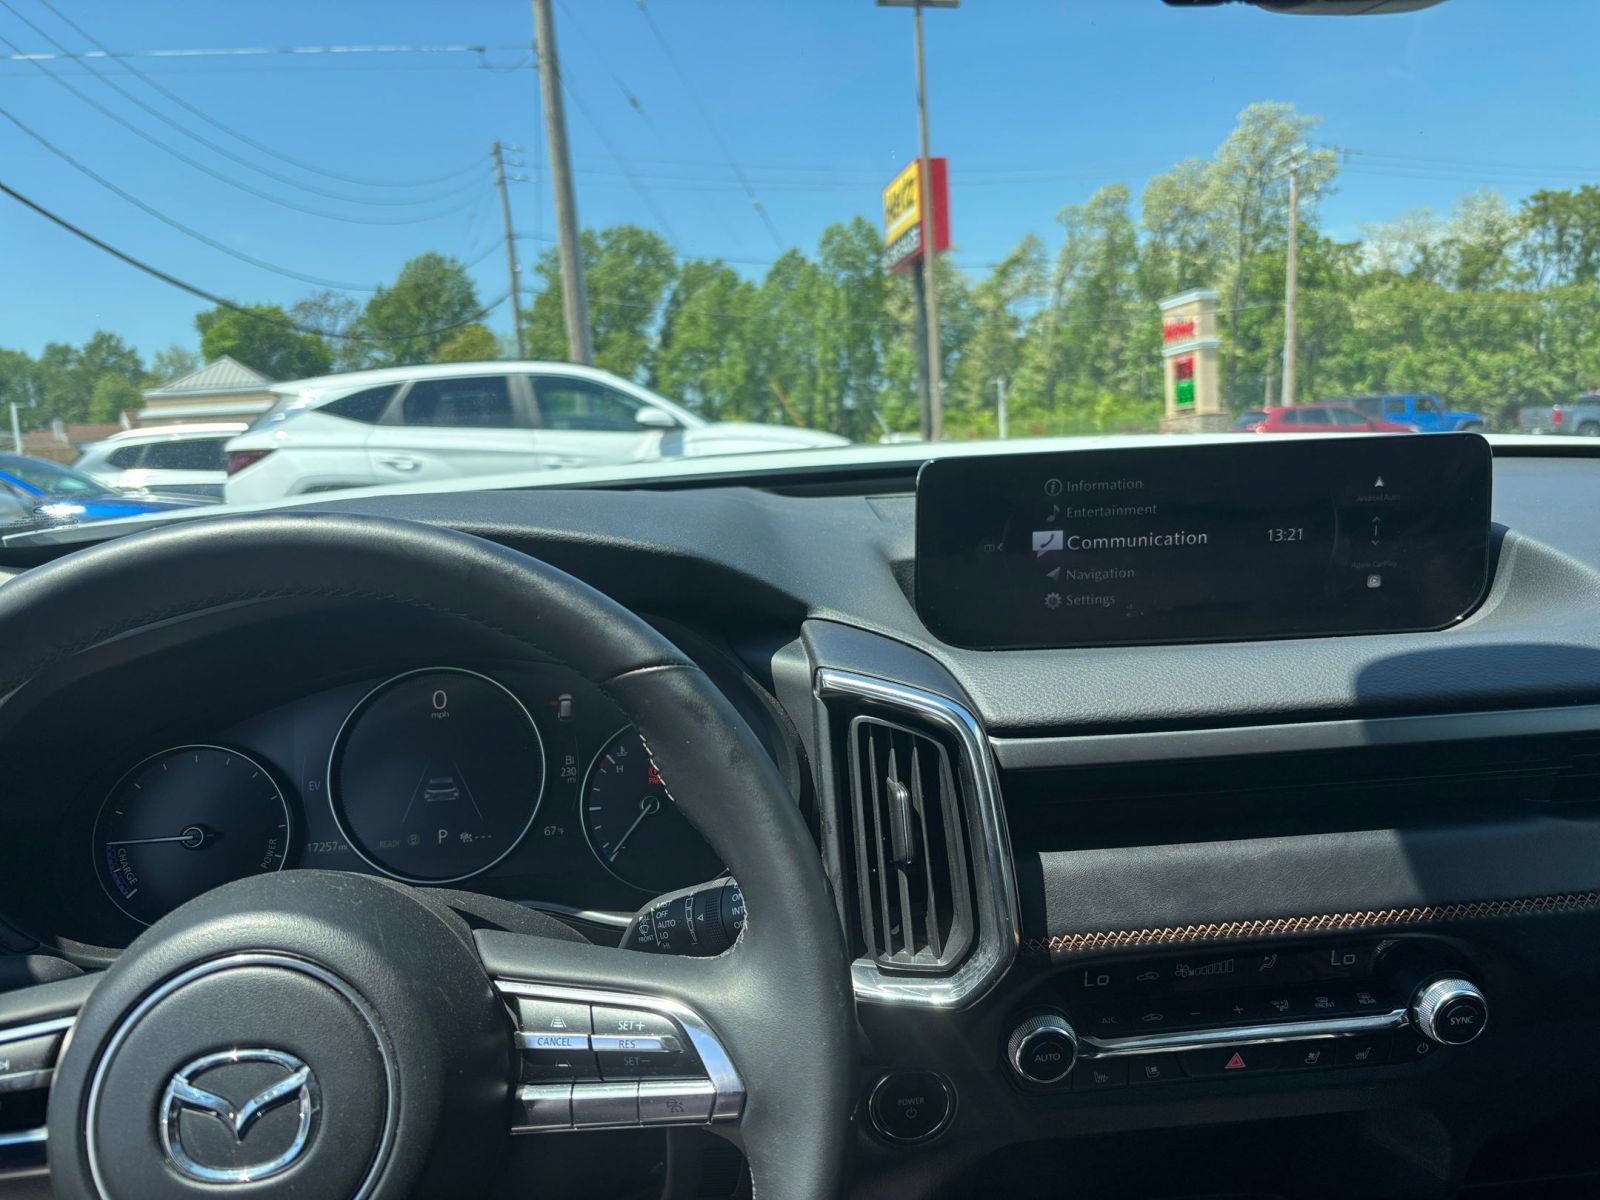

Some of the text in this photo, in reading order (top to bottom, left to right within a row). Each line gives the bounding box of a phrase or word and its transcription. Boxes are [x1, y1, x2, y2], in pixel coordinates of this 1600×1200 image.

[1066, 478, 1144, 492] Information
[1066, 504, 1158, 519] Entertainment
[1067, 531, 1208, 550] Communication
[1266, 528, 1304, 542] 13:21
[1066, 567, 1136, 582] Navigation
[1066, 593, 1116, 608] Settings
[432, 689, 448, 710] 0
[431, 711, 450, 720] mph
[560, 766, 577, 777] 230
[615, 765, 624, 774] H
[308, 780, 321, 792] EV
[437, 829, 448, 844] P
[260, 838, 278, 869] POWER
[117, 848, 138, 886] CHARGE
[656, 911, 668, 919] OFF
[731, 906, 744, 916] INT
[658, 920, 676, 929] AUTO
[660, 932, 669, 940] LO
[1331, 949, 1356, 966] Lo
[1083, 970, 1110, 987] Lo
[1101, 1016, 1118, 1025] A/C
[1450, 1015, 1474, 1026] SYNC
[537, 1037, 572, 1047] CANCEL
[618, 1039, 636, 1049] RES
[1033, 1052, 1061, 1063] AUTO
[897, 1096, 925, 1106] POWER
